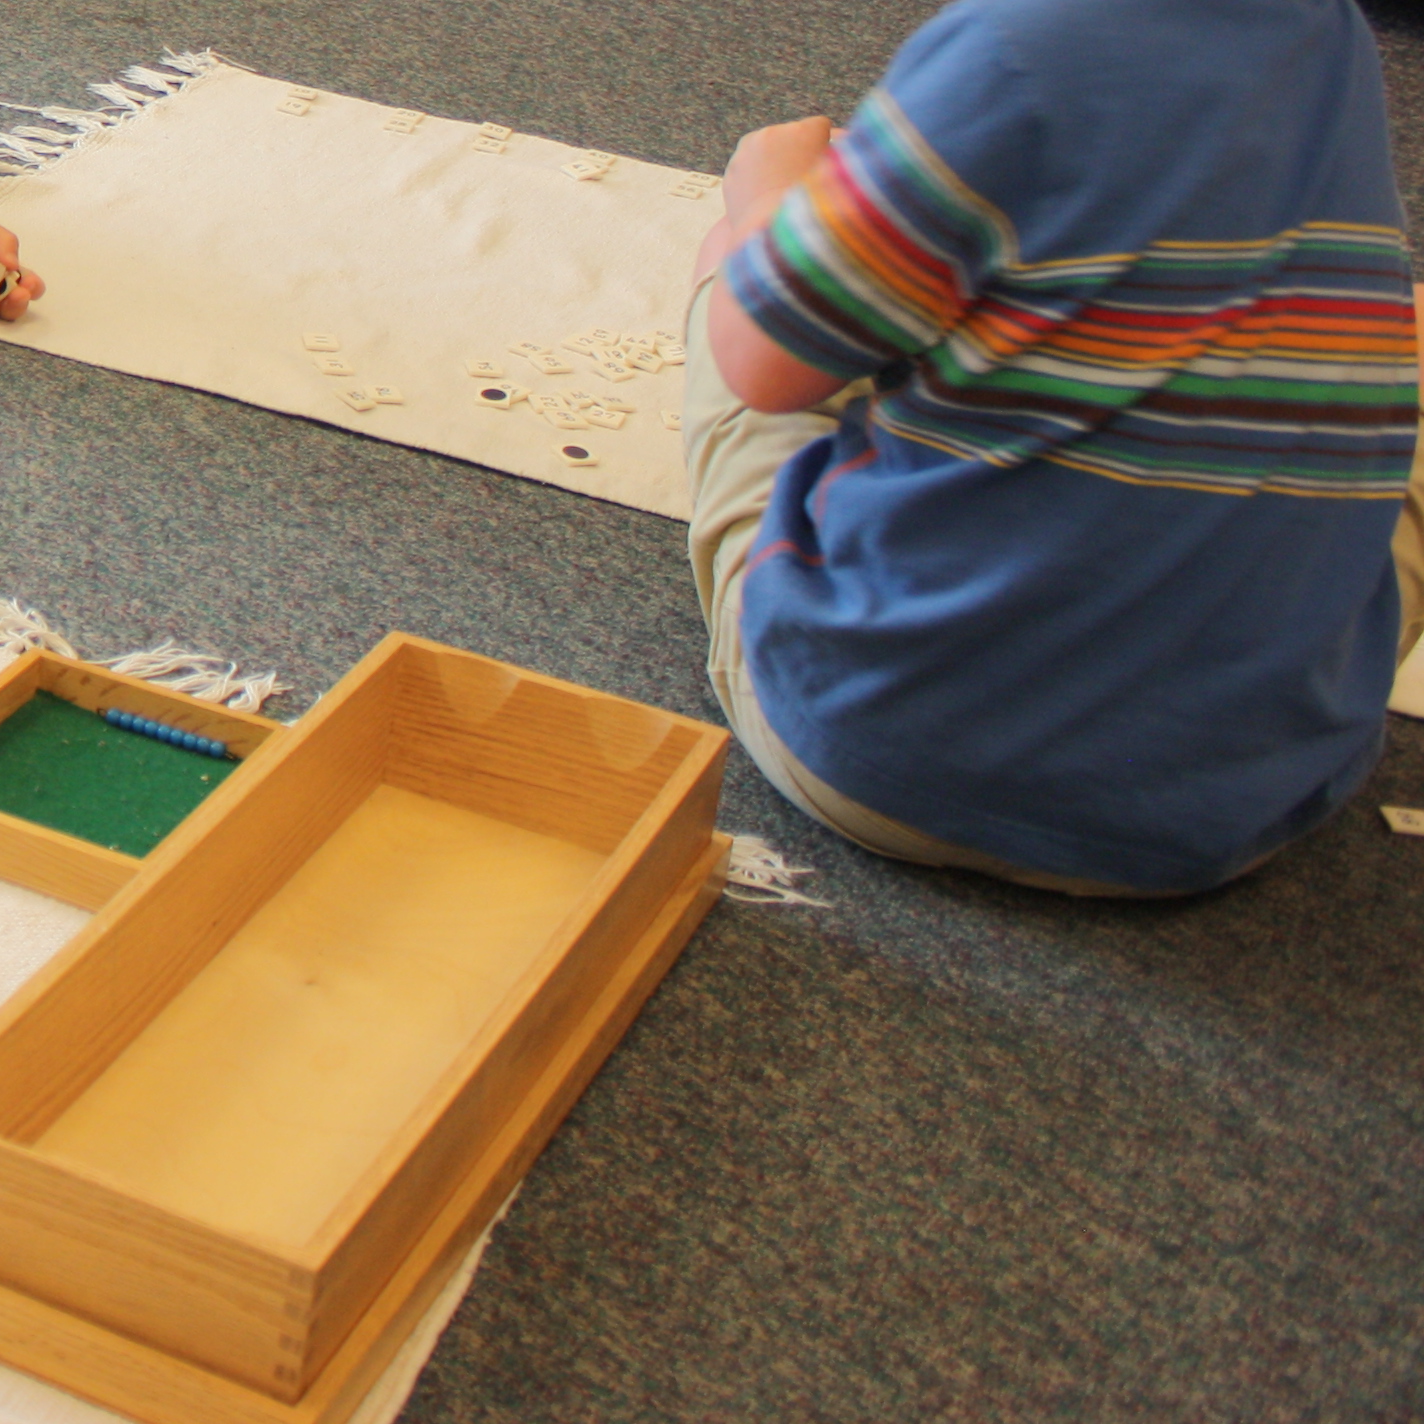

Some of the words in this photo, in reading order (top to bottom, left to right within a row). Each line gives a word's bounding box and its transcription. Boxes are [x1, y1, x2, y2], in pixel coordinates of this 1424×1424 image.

[575, 336, 595, 347] 12
[539, 395, 560, 408] 23
[592, 409, 617, 420] 27
